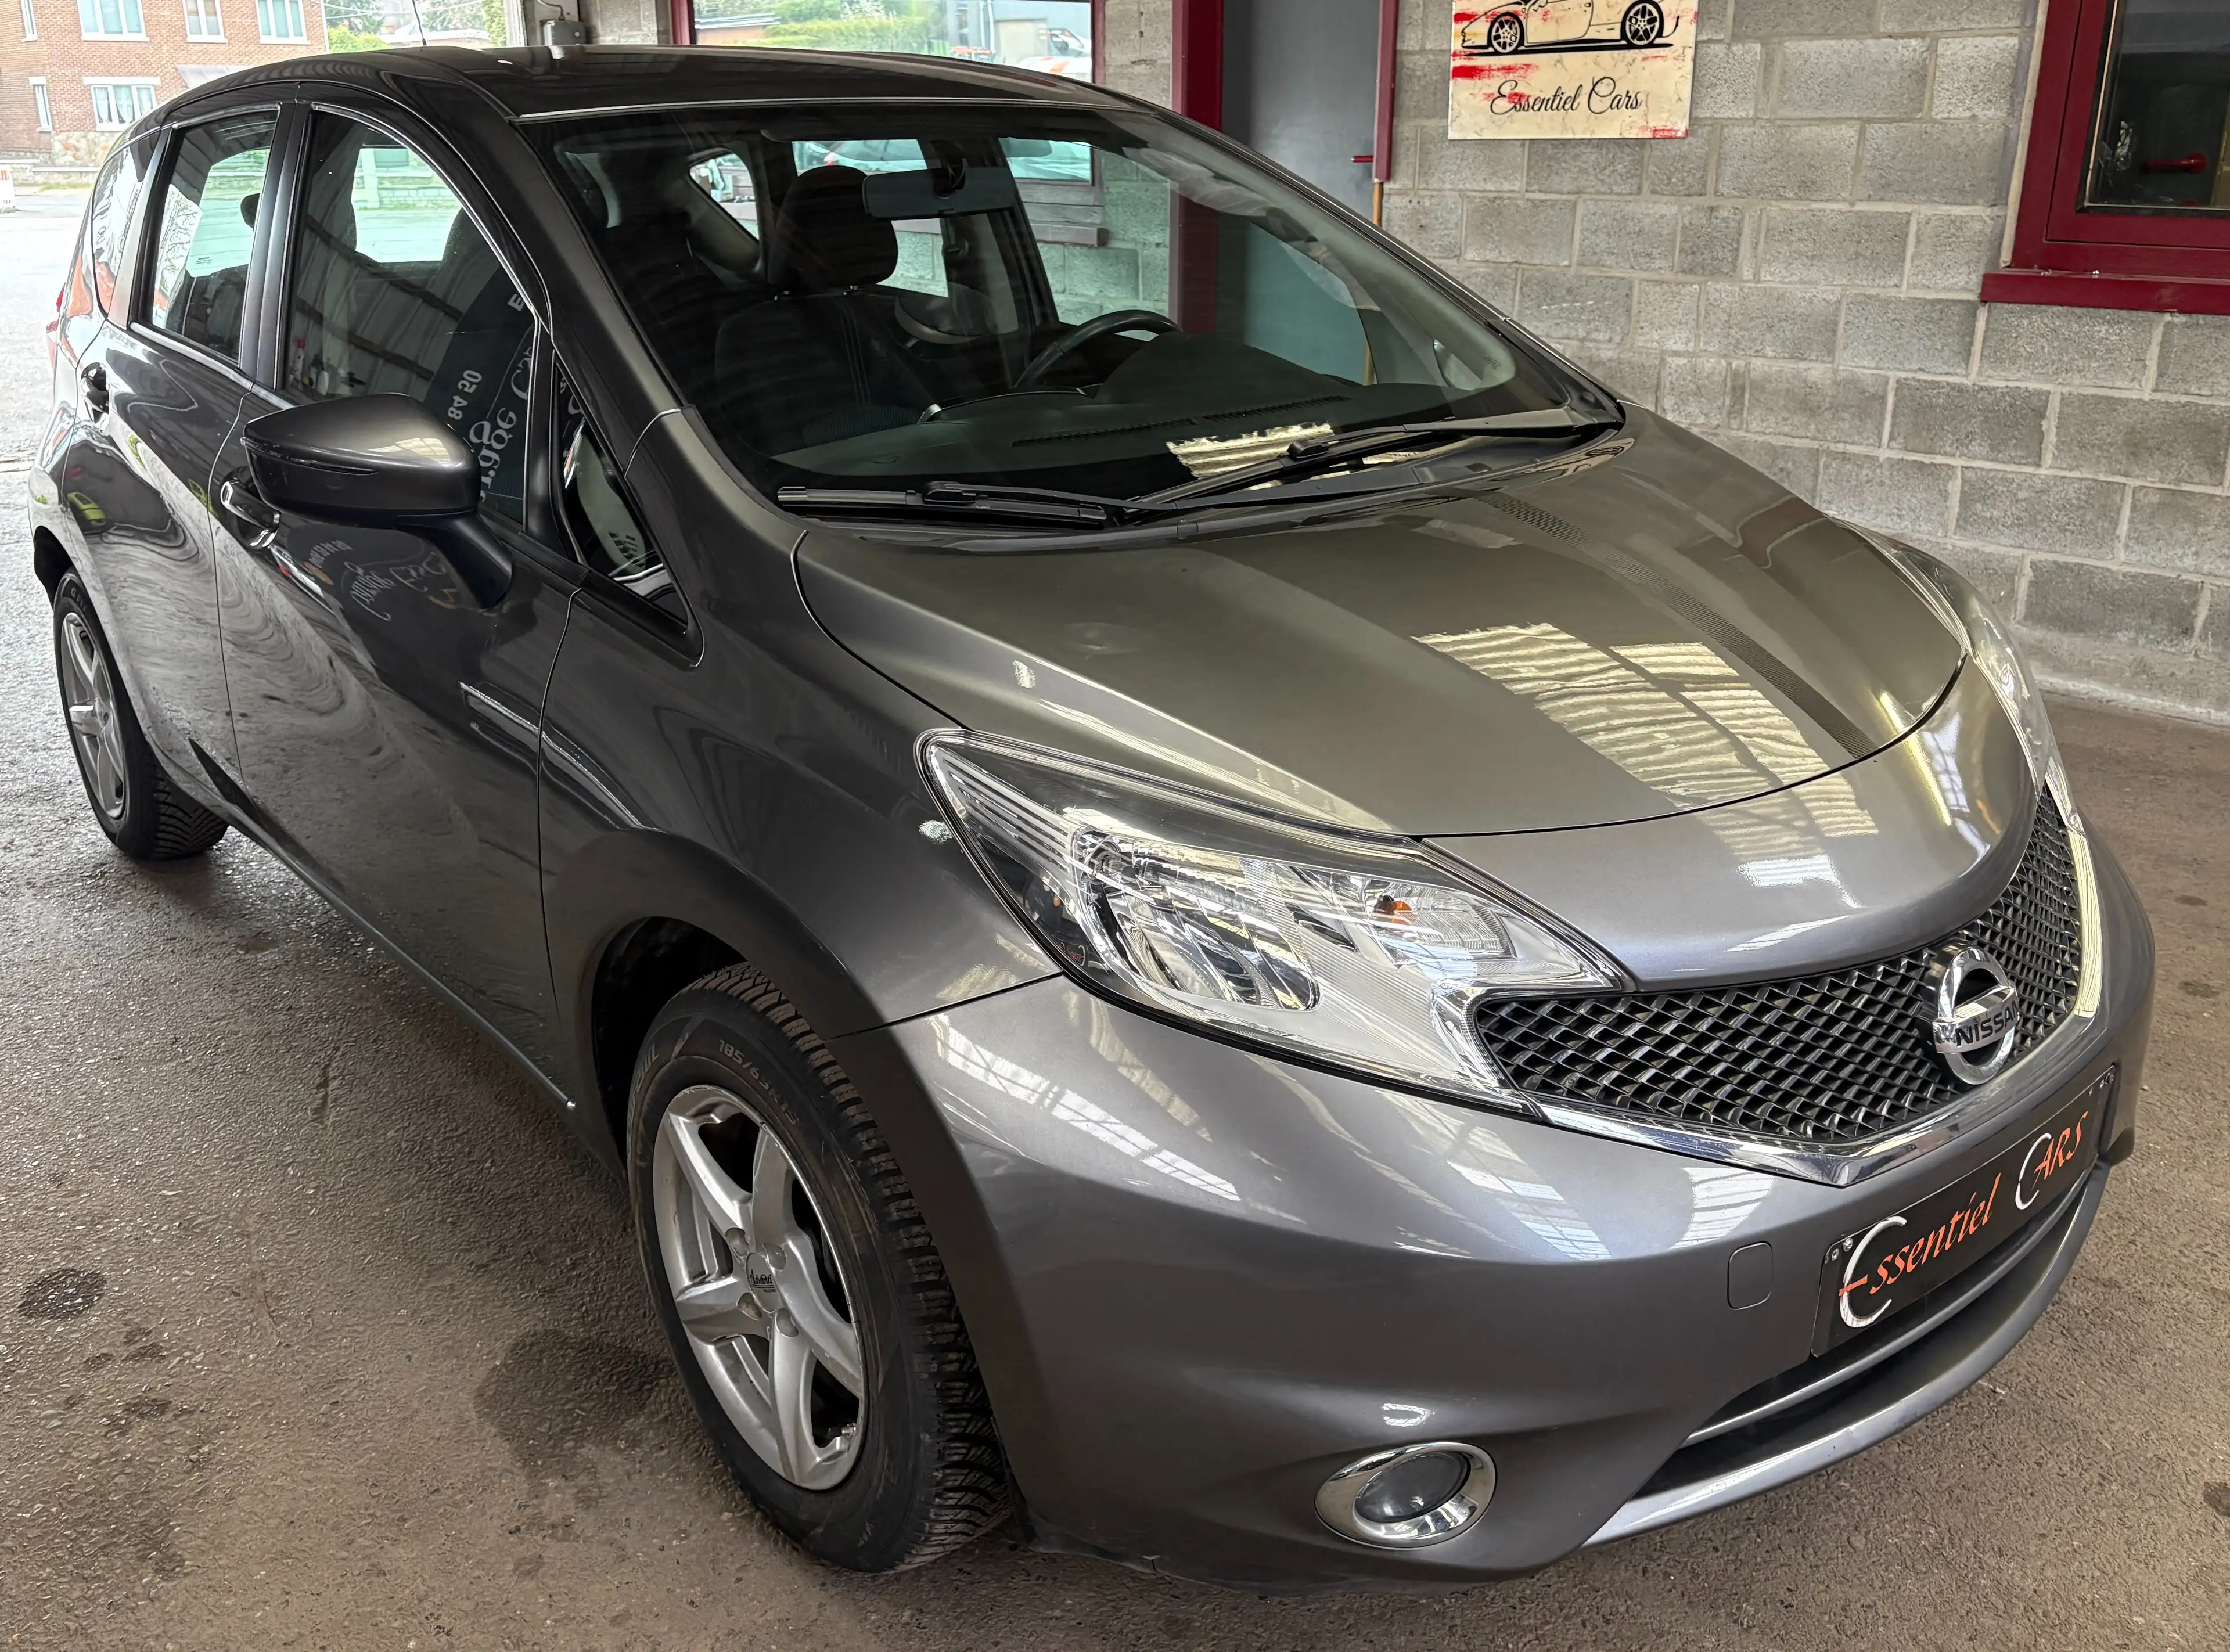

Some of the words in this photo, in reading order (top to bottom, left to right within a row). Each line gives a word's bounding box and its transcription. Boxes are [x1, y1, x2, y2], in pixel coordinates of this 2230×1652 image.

[1490, 80, 1584, 114] Essentiel
[1588, 77, 1643, 114] Cars
[1839, 1173, 2001, 1328] Essentiel
